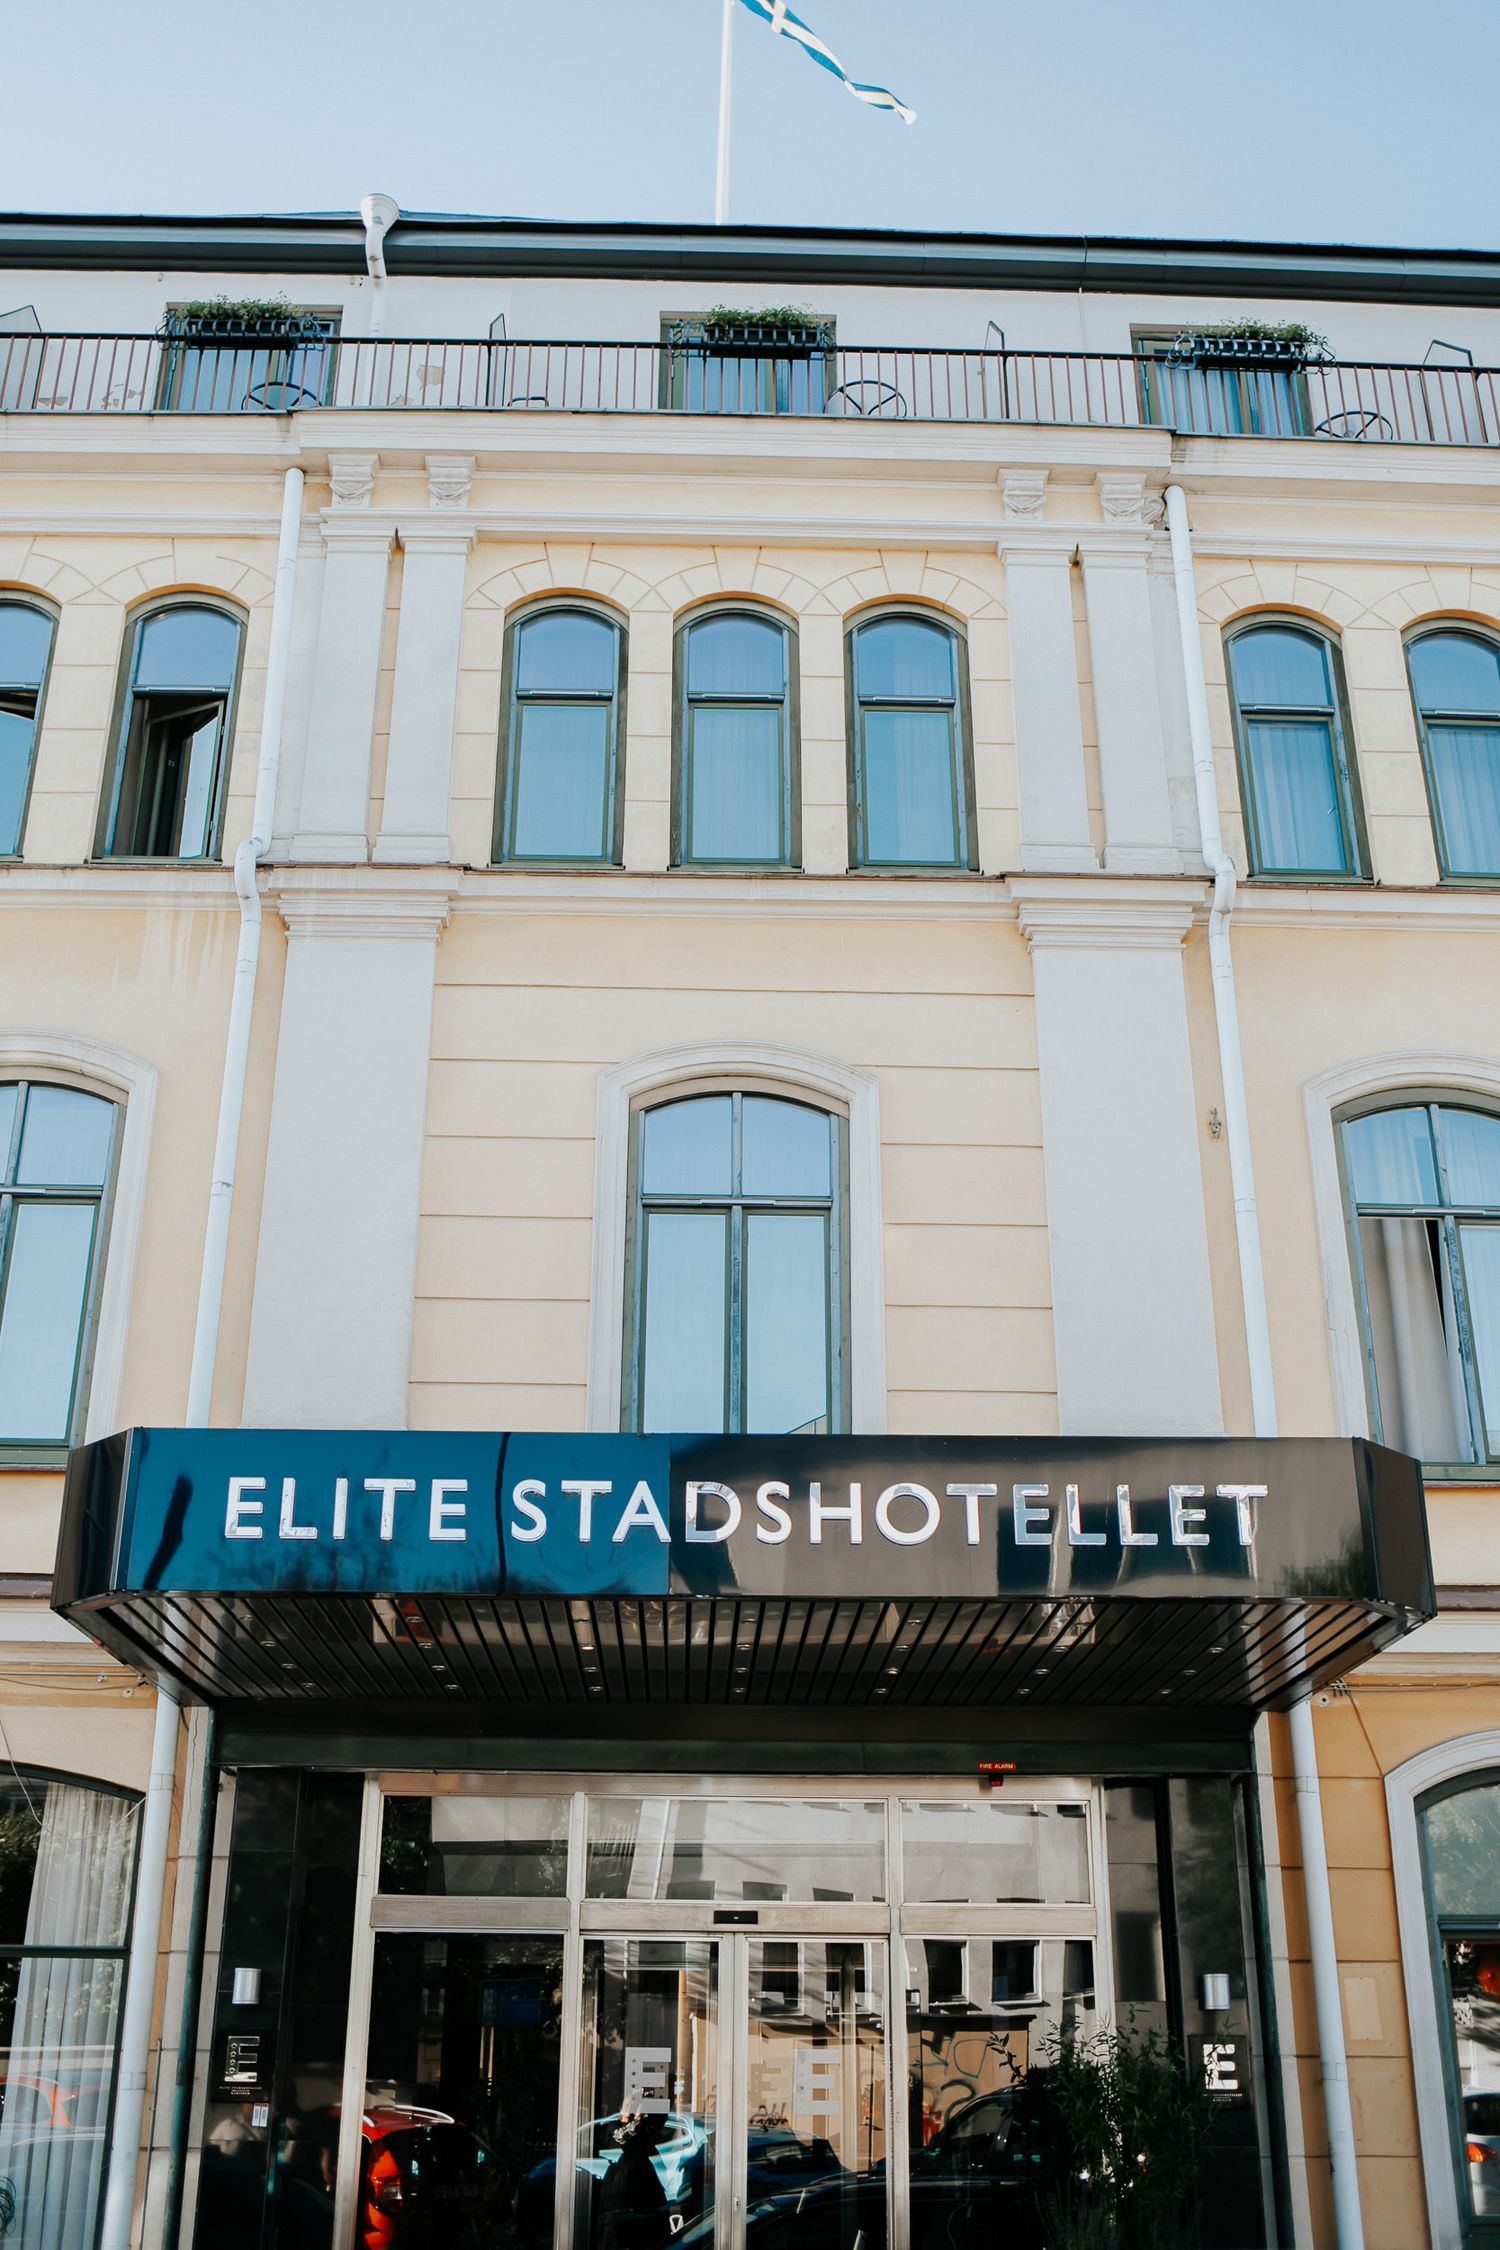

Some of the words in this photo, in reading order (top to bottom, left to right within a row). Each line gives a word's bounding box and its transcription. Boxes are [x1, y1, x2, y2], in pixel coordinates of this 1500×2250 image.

[225, 1477, 468, 1541] ELITE
[511, 1479, 1268, 1544] STADSHOTELLET
[224, 2036, 260, 2082] E
[624, 2047, 671, 2114] E
[795, 2049, 840, 2115] E
[1203, 2044, 1238, 2090] E
